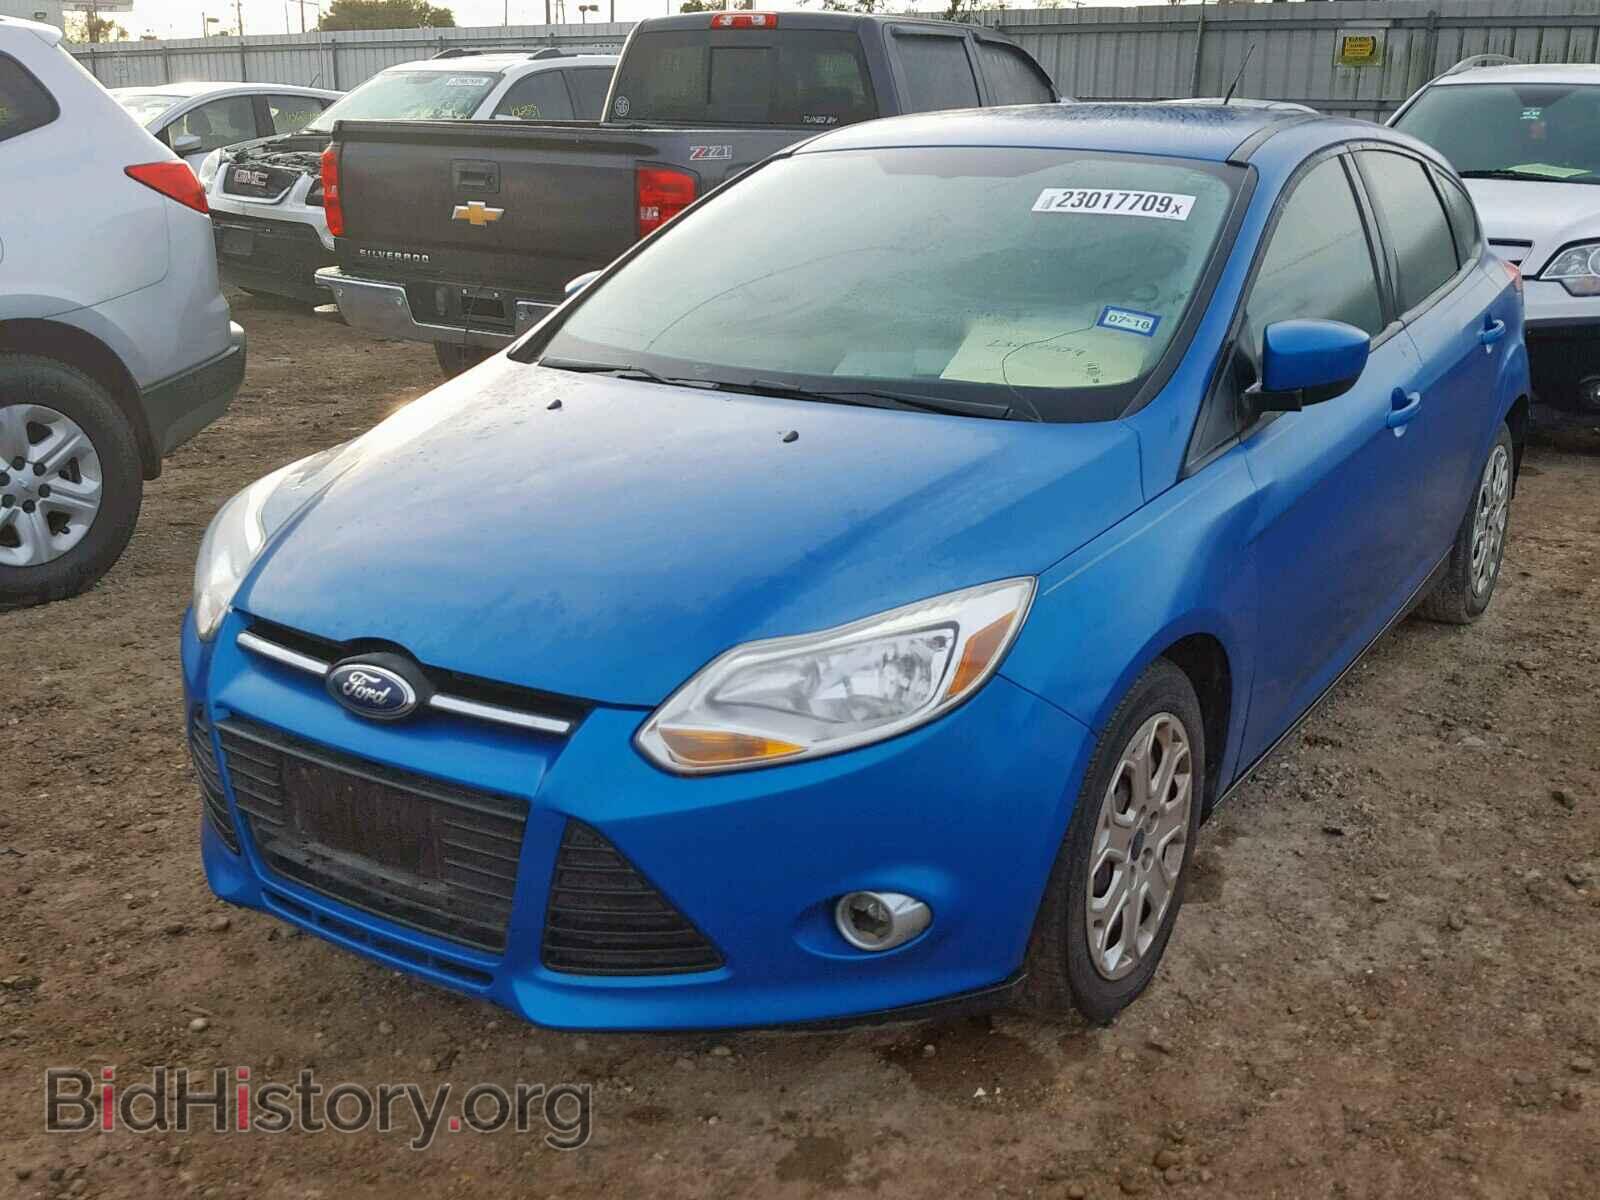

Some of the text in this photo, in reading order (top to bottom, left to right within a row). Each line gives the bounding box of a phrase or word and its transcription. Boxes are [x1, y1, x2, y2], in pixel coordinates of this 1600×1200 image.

[234, 169, 269, 187] GMC
[359, 248, 430, 263] SILVERADO
[343, 671, 391, 704] Ford
